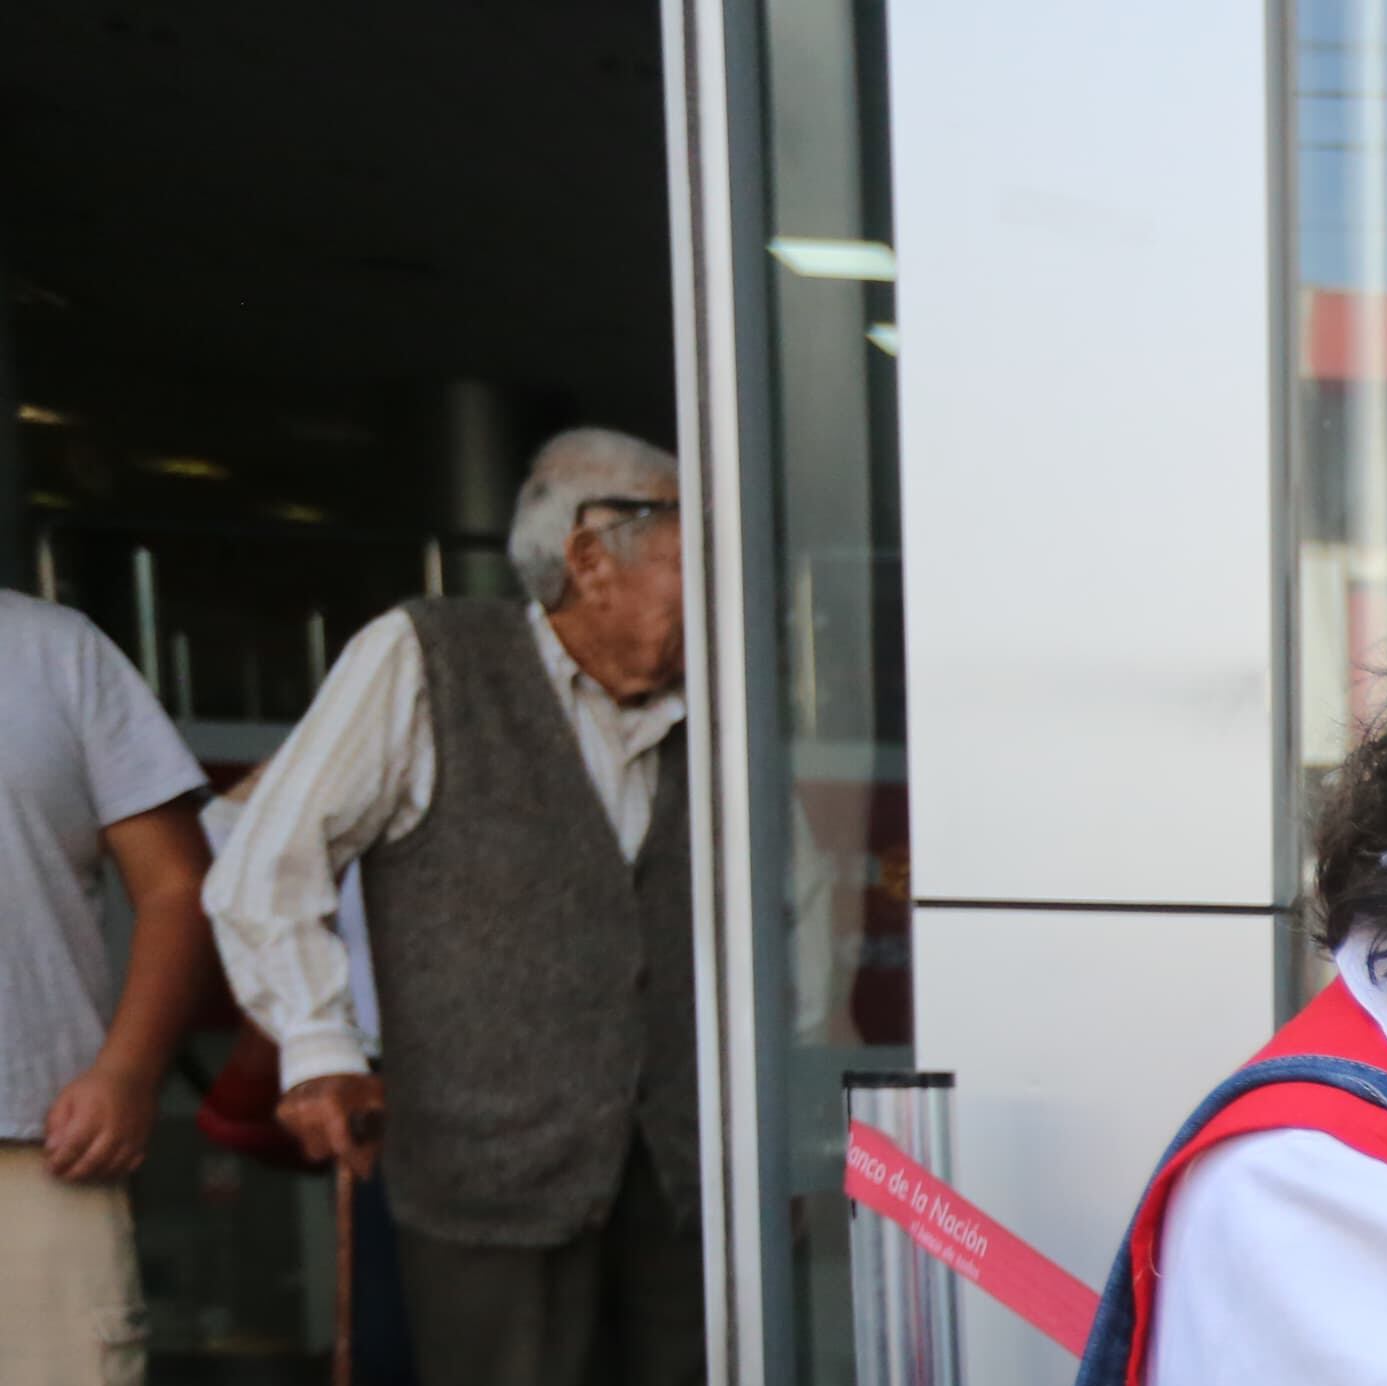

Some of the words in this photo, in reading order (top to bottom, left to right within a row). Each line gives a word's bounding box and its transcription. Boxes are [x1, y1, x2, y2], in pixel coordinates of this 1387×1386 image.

[888, 1166, 909, 1201] de
[911, 1180, 929, 1214] la
[929, 1196, 989, 1258] Nación
